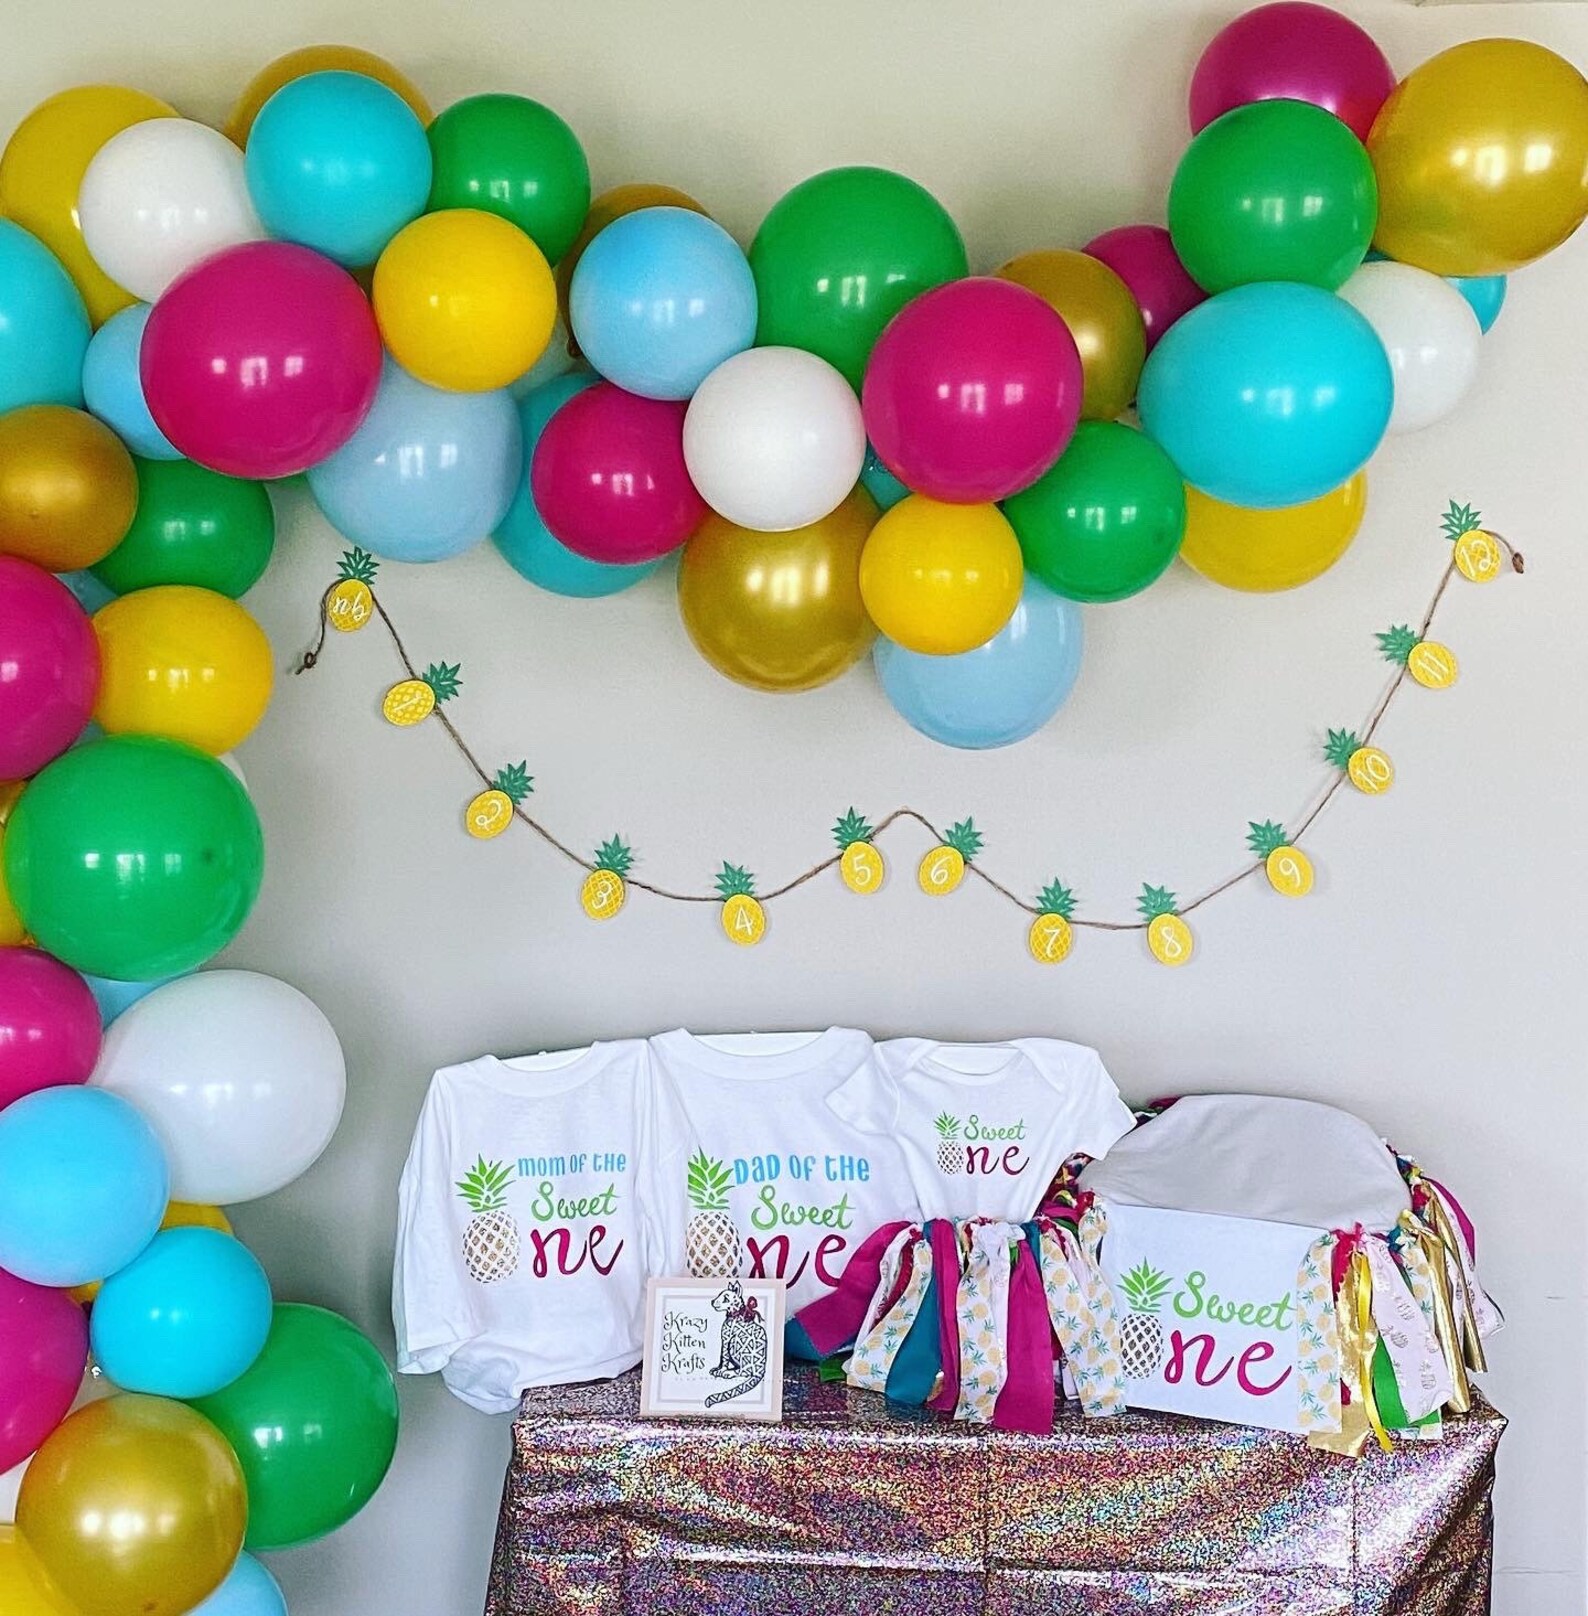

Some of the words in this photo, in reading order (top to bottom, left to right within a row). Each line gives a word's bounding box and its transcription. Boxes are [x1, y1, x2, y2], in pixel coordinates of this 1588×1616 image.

[1460, 540, 1493, 577] 12
[1416, 651, 1449, 682] 11
[1356, 754, 1392, 791] 10
[475, 799, 503, 832] 2
[851, 853, 872, 886] 5
[930, 856, 952, 885] 6
[1278, 857, 1301, 889] 9
[592, 880, 614, 910] 3
[735, 906, 754, 937] 4
[1043, 928, 1060, 958] 7
[1160, 926, 1182, 958] 8
[963, 1114, 1028, 1142] Sweet
[531, 1181, 622, 1222] Sweet
[751, 1184, 856, 1231] Sweet
[1172, 1270, 1297, 1332] Sweet
[663, 1311, 708, 1334] Krazy
[662, 1332, 706, 1354] Kitten
[661, 1352, 706, 1375] Krafts
